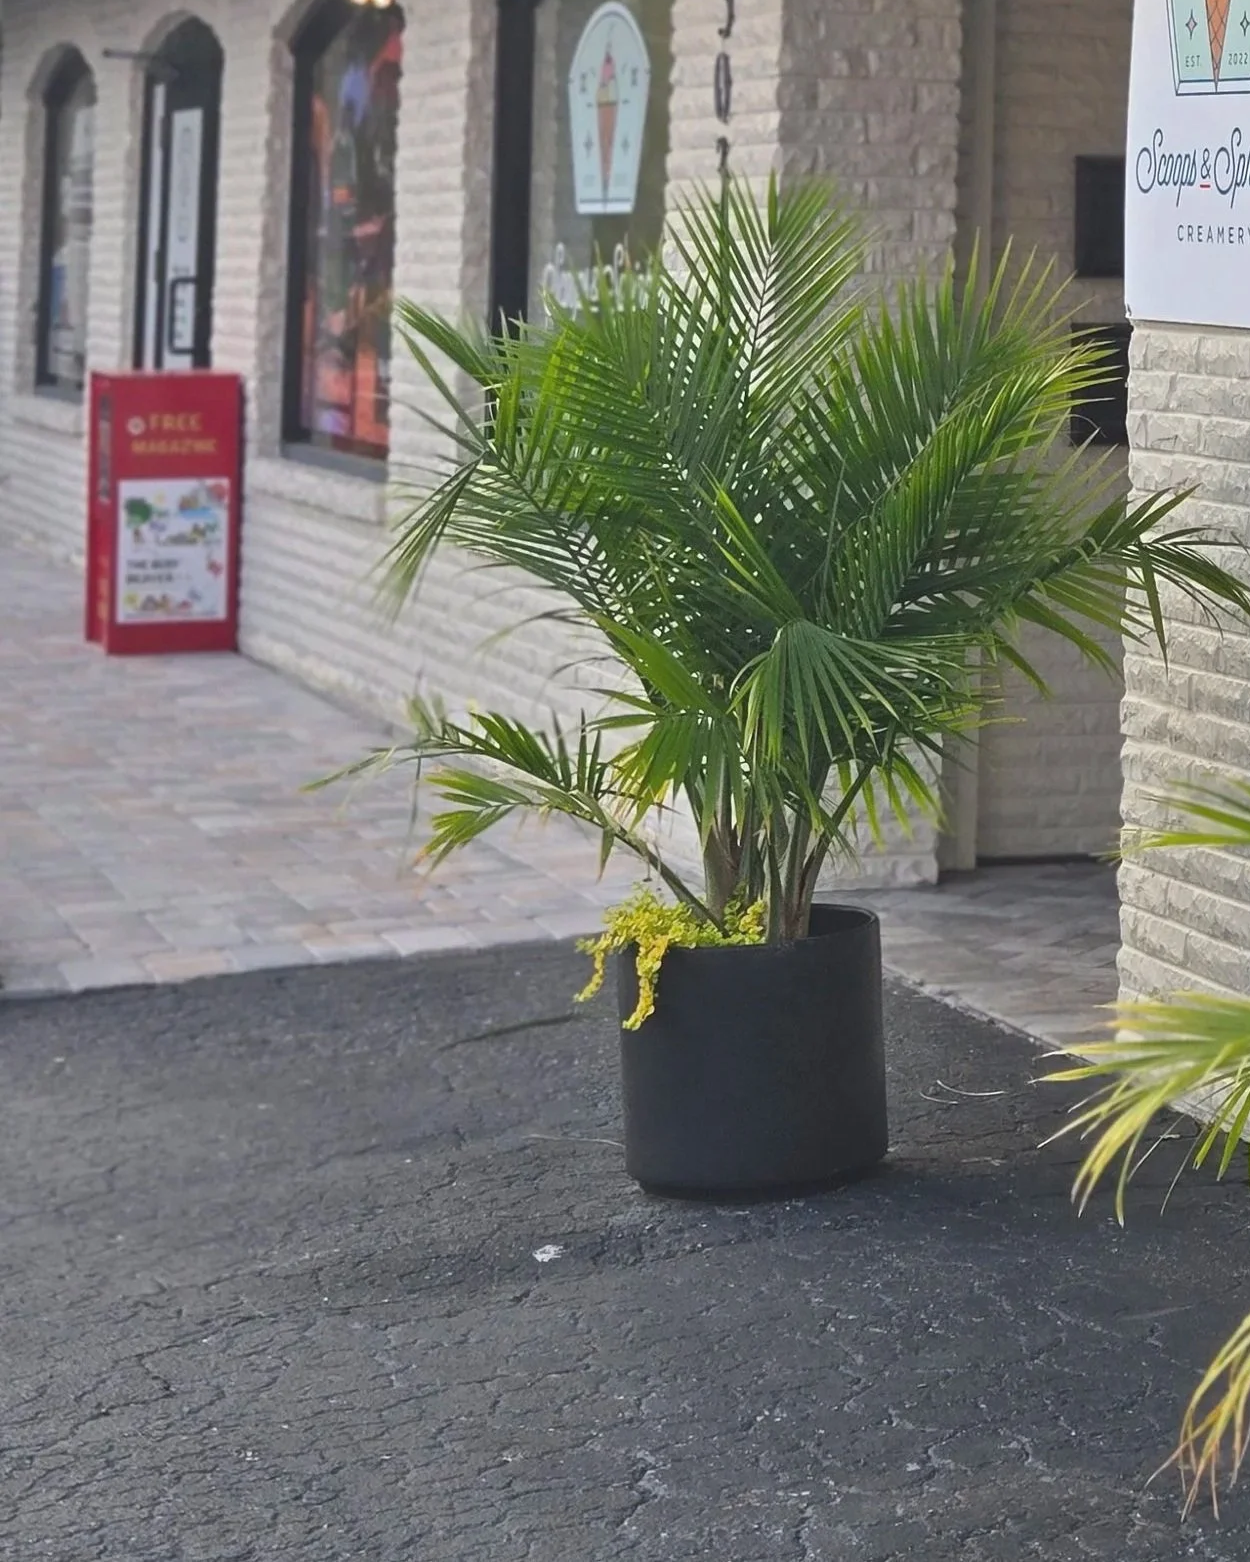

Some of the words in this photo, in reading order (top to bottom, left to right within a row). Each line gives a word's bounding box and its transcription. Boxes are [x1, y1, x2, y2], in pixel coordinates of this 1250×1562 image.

[1228, 52, 1248, 65] 2022
[1136, 128, 1197, 207] Scoops
[1200, 149, 1211, 181] &
[150, 413, 202, 431] FREE
[131, 439, 217, 455] MAGAZINE
